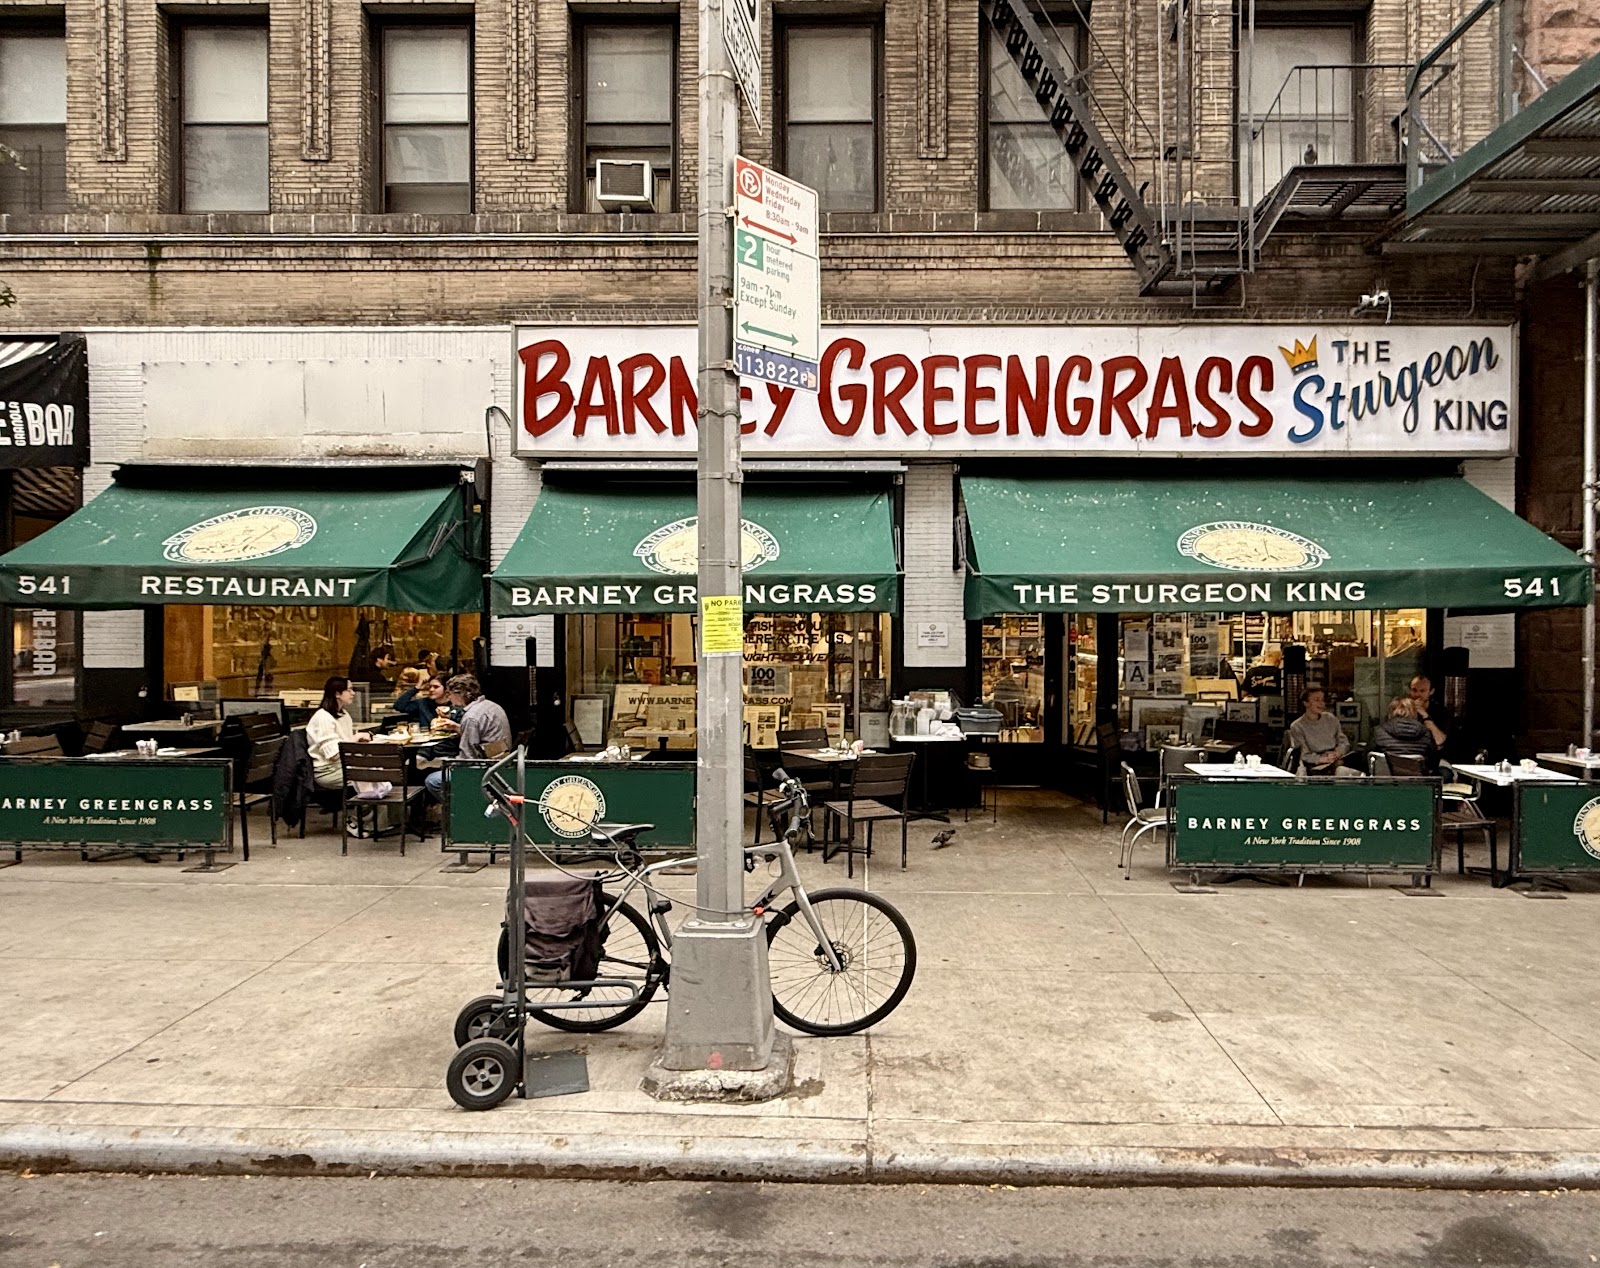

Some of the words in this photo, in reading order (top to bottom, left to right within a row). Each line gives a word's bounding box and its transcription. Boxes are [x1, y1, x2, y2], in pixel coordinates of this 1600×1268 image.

[765, 174, 790, 194] Monday
[766, 186, 801, 210] Wednesday
[766, 196, 785, 213] Friday
[766, 210, 790, 227] 8:30am
[795, 221, 809, 235] 9am
[743, 235, 758, 266] 2
[766, 243, 781, 256] hour
[766, 255, 793, 271] metered
[766, 267, 790, 283] parking
[740, 276, 758, 292] 9am
[765, 284, 782, 300] 7pm
[740, 290, 767, 309] Except
[769, 301, 797, 319] Sunday
[1331, 339, 1391, 365] THE
[737, 353, 799, 385] 113822
[817, 337, 1274, 439] GREENGRASS
[1288, 335, 1499, 443] Sturgeon
[8, 401, 27, 447] GRANOLA
[23, 402, 75, 446] BAR
[1434, 399, 1508, 431] KING
[636, 520, 689, 556] BARNEY
[1181, 525, 1210, 555] BARNEY
[18, 575, 71, 596] 541
[140, 575, 357, 598] RESTAURANT
[511, 585, 643, 606] BARNEY
[653, 584, 877, 605] GRNGRASS
[1013, 584, 1079, 604] THE
[1091, 582, 1272, 604] STURGEON
[1286, 581, 1366, 602] KING
[1504, 577, 1560, 598] 541
[33, 638, 57, 675] BAR
[751, 668, 776, 680] 100
[1129, 665, 1145, 683] A
[79, 799, 214, 811] GREENGRASS
[42, 816, 50, 824] A
[51, 816, 68, 824] New
[68, 816, 85, 824] York
[85, 816, 117, 825] Tradition
[118, 817, 137, 825] Since
[138, 817, 157, 825] 1908
[1187, 817, 1270, 830] BARNEY
[1281, 818, 1422, 831] GREENGRASS
[1244, 836, 1252, 845] A
[1252, 836, 1269, 845] New
[1270, 836, 1287, 845] York
[1288, 836, 1321, 846] Tradition
[1321, 836, 1341, 846] Since
[1342, 836, 1362, 846] 1908
